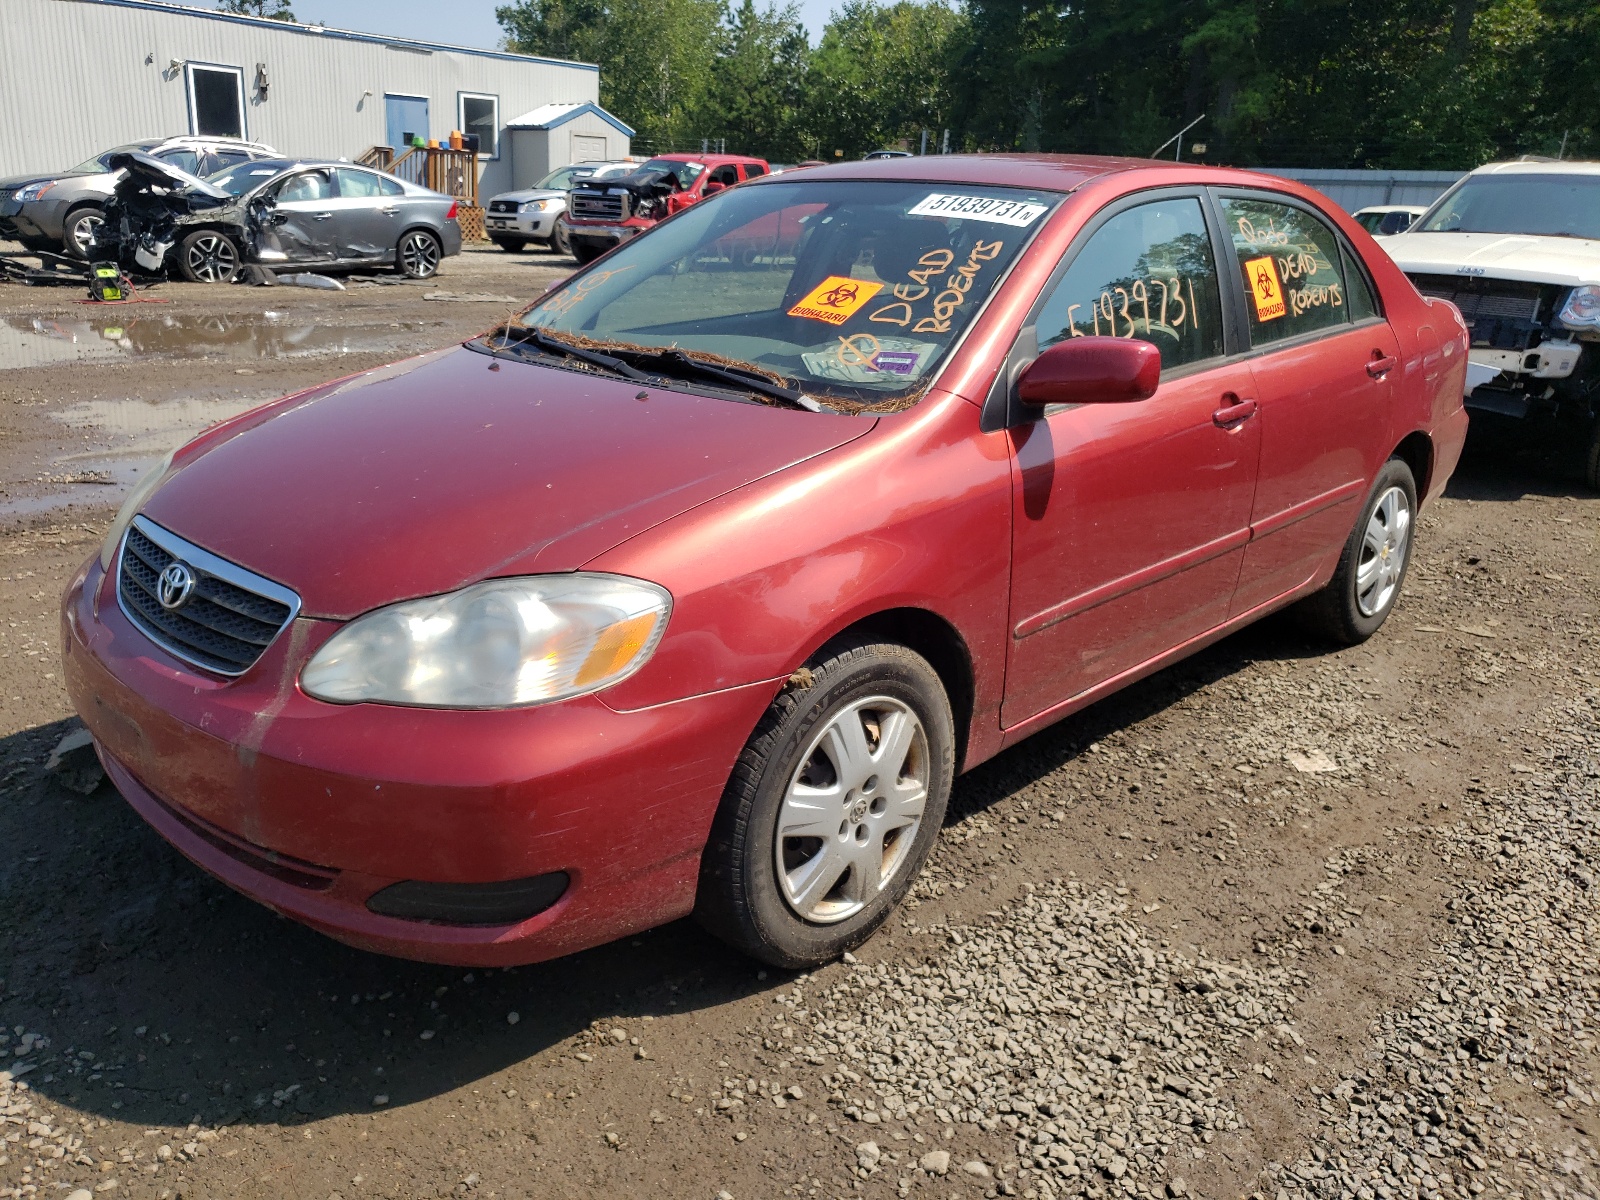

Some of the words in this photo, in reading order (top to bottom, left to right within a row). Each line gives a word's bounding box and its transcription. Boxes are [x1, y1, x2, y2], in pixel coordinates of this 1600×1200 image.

[929, 195, 1028, 219] 51939731
[1278, 252, 1317, 284] DEAD
[869, 248, 954, 327] DEAD
[911, 240, 1004, 333] RODENTS
[1289, 283, 1342, 317] RODENTS
[791, 306, 848, 324] BIOHAZARD
[1067, 277, 1198, 339] 51939731
[1258, 302, 1285, 319] BIOHAZARD
